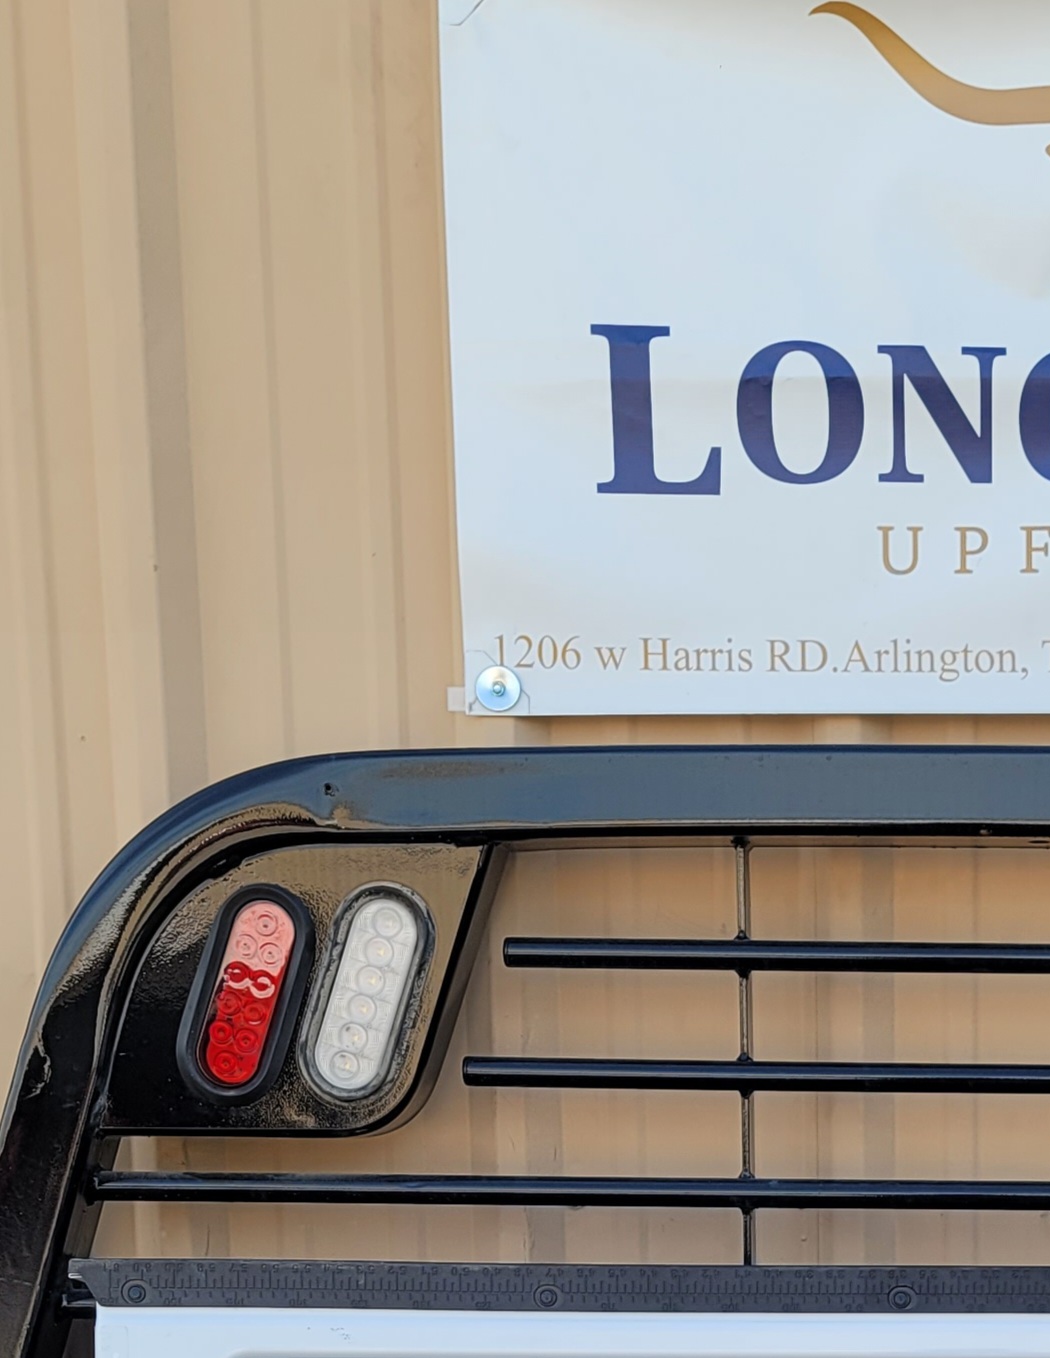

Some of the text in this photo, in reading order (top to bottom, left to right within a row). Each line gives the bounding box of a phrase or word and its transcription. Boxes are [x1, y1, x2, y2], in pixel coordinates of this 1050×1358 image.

[495, 634, 582, 671] 1206
[594, 646, 627, 671] w
[639, 636, 753, 673] Harris
[766, 638, 1030, 683] RD.Arlington,
